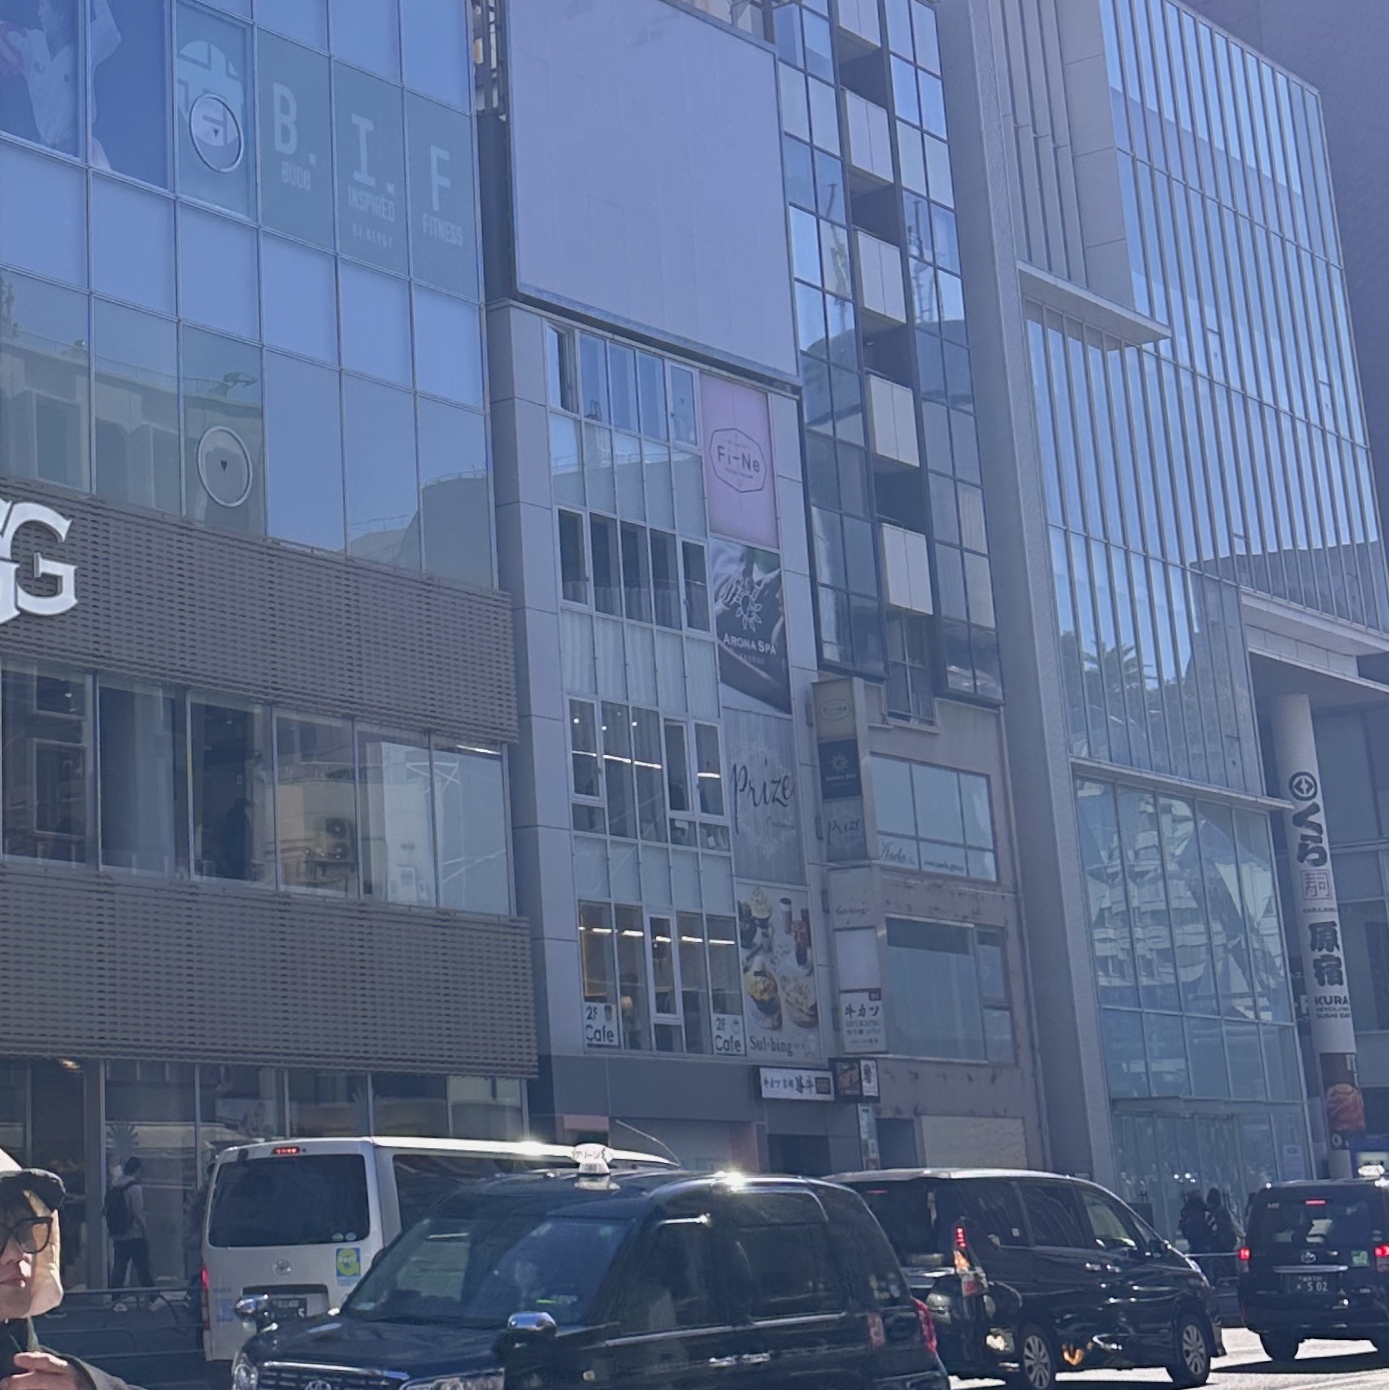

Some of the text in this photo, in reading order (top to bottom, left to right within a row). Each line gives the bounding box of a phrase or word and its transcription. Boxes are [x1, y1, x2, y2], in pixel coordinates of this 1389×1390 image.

[429, 144, 452, 212] F
[347, 185, 396, 223] INSPIRED
[422, 213, 464, 247] FITNESS
[716, 444, 761, 474] Fi-Ne
[732, 756, 796, 835] Prize
[1308, 920, 1344, 987] 原宿
[586, 1006, 599, 1020] 2F
[1314, 995, 1348, 1006] KURA
[585, 1024, 615, 1043] Cafe
[714, 1035, 742, 1052] Cafe
